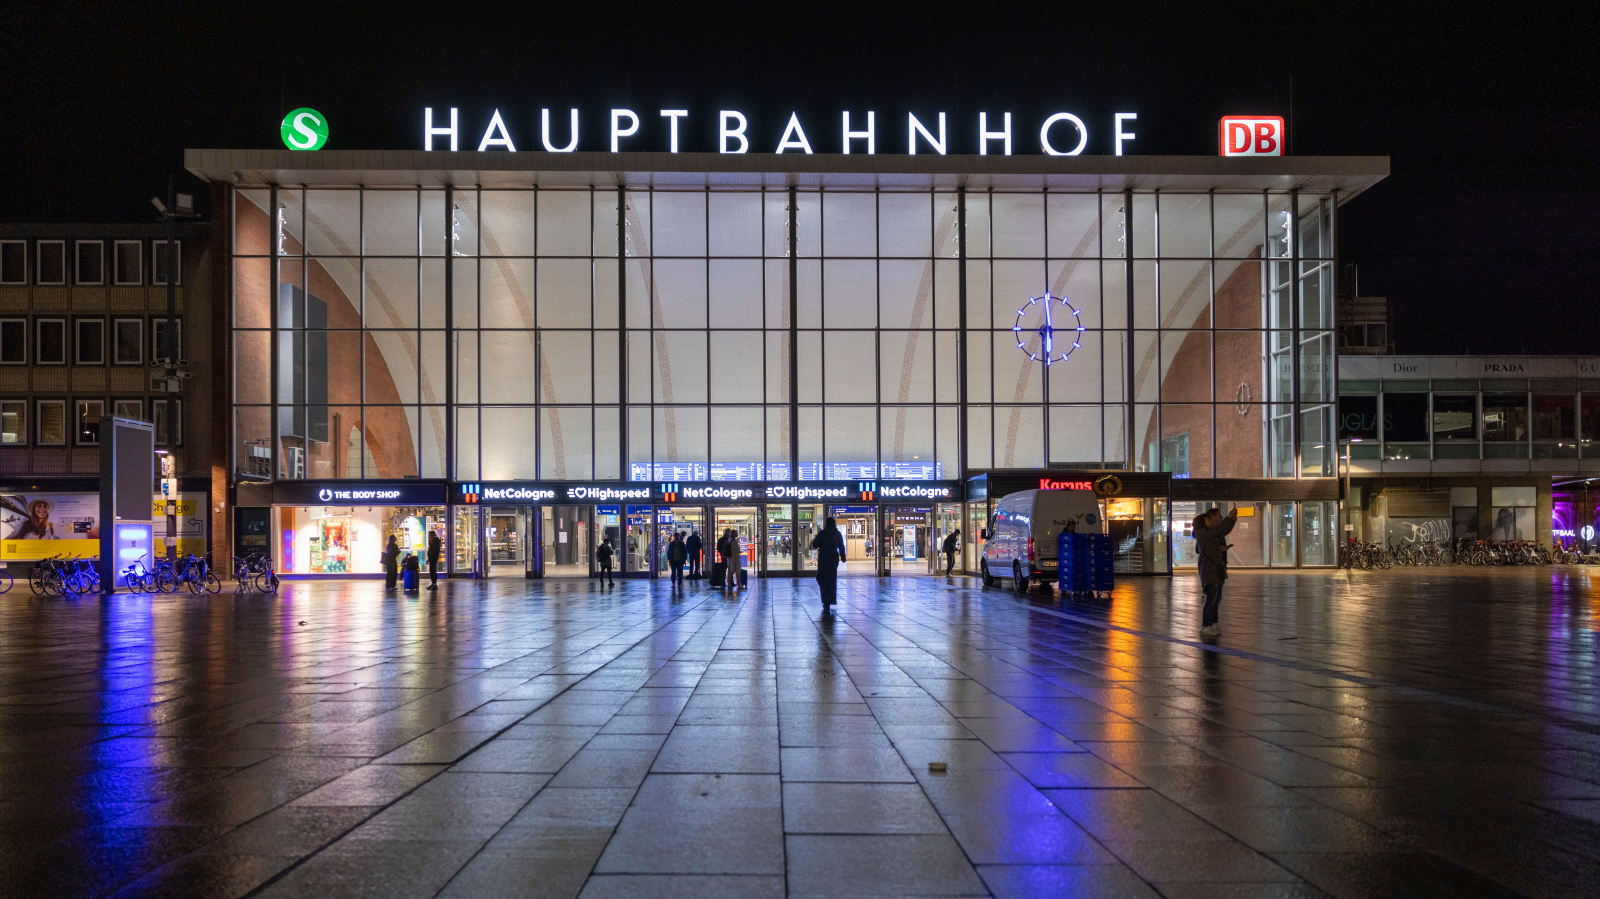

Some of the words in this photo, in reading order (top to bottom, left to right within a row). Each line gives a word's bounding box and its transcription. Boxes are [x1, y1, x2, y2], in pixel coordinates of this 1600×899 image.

[288, 112, 321, 149] S
[423, 106, 1138, 156] HAUPTBAHNHOF
[1229, 123, 1277, 153] DB
[1393, 363, 1418, 372] Dior
[1485, 364, 1524, 372] PRADA
[334, 490, 351, 499] THE
[352, 490, 376, 499] BODY
[376, 490, 400, 499] SHOP
[484, 487, 555, 502] NetCologne
[587, 486, 650, 501] Highspeed
[683, 486, 753, 501] NetCologne
[785, 485, 848, 500] Highspeed
[880, 485, 950, 499] NetCologne
